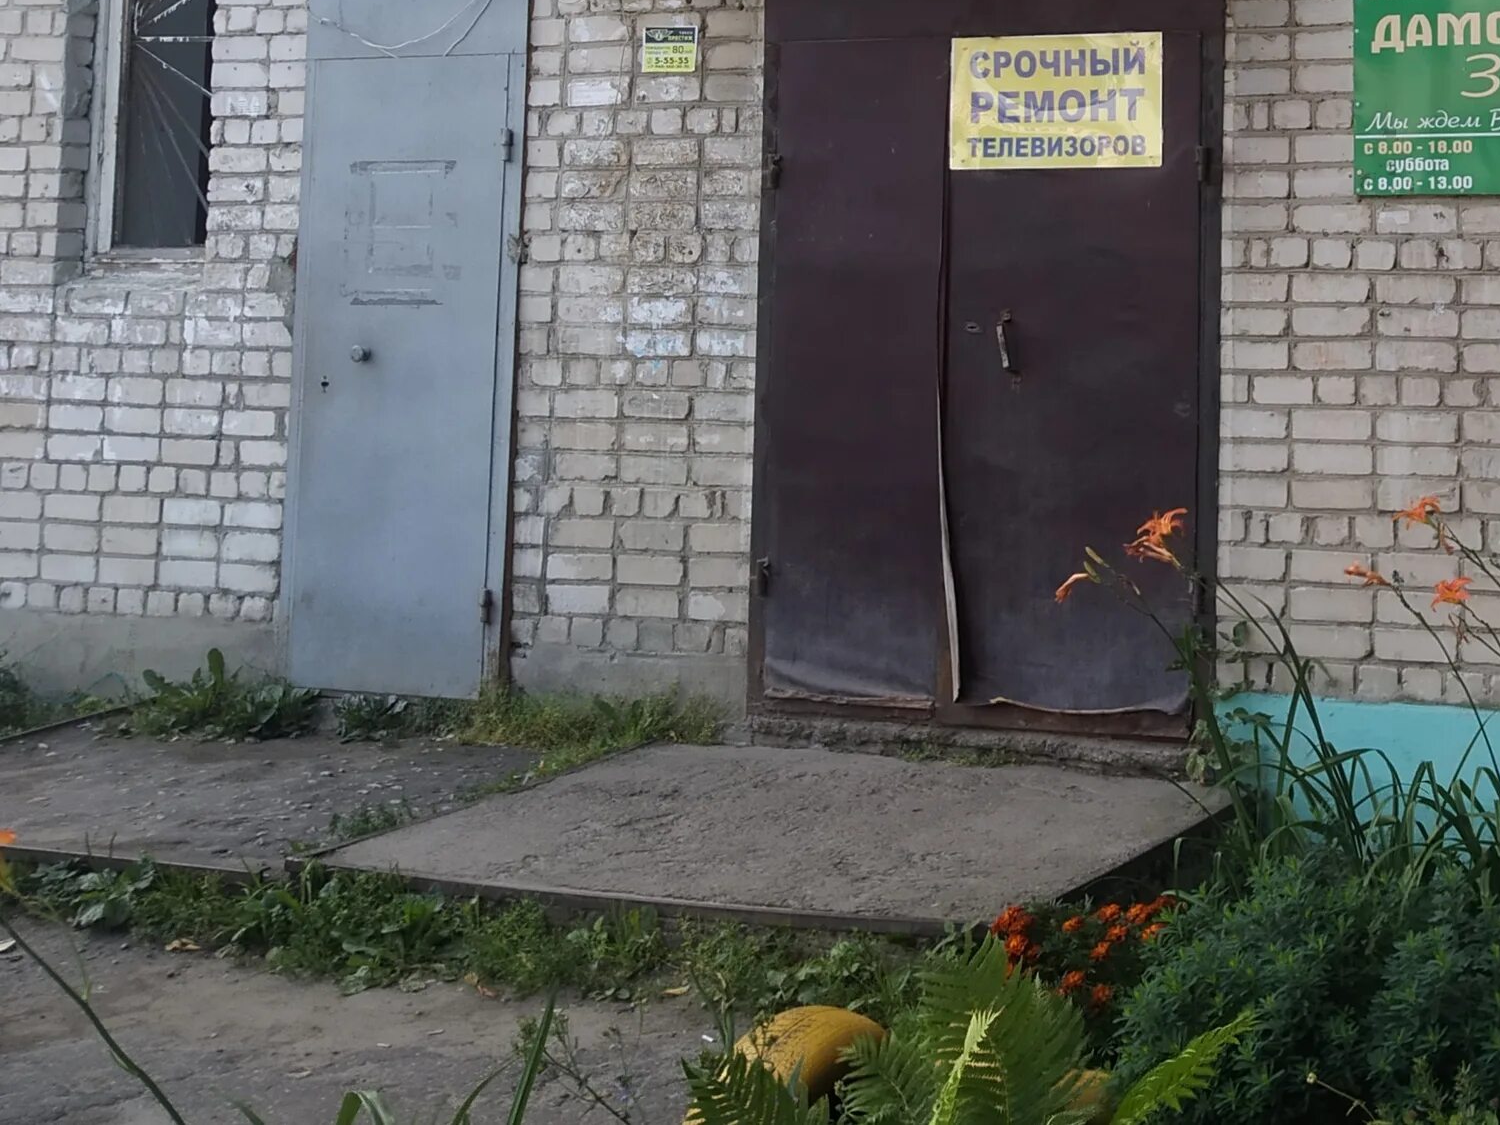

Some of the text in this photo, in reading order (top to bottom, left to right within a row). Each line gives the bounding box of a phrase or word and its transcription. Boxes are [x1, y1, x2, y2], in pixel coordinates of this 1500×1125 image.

[969, 40, 1146, 79] СРОЧНЫЙ
[970, 88, 1146, 124] РЕМОНТ
[1365, 111, 1409, 132] Мы
[1416, 109, 1482, 129] ждем
[967, 134, 1146, 159] ТЕЛЕВИЗОРОВ
[1363, 142, 1374, 155] с
[1378, 141, 1413, 155] 8.00
[1428, 140, 1473, 154] 18.00
[1386, 157, 1450, 173] суббота
[1363, 178, 1374, 191] с
[1378, 177, 1413, 190] 8.00
[1428, 176, 1473, 190] 13.00
